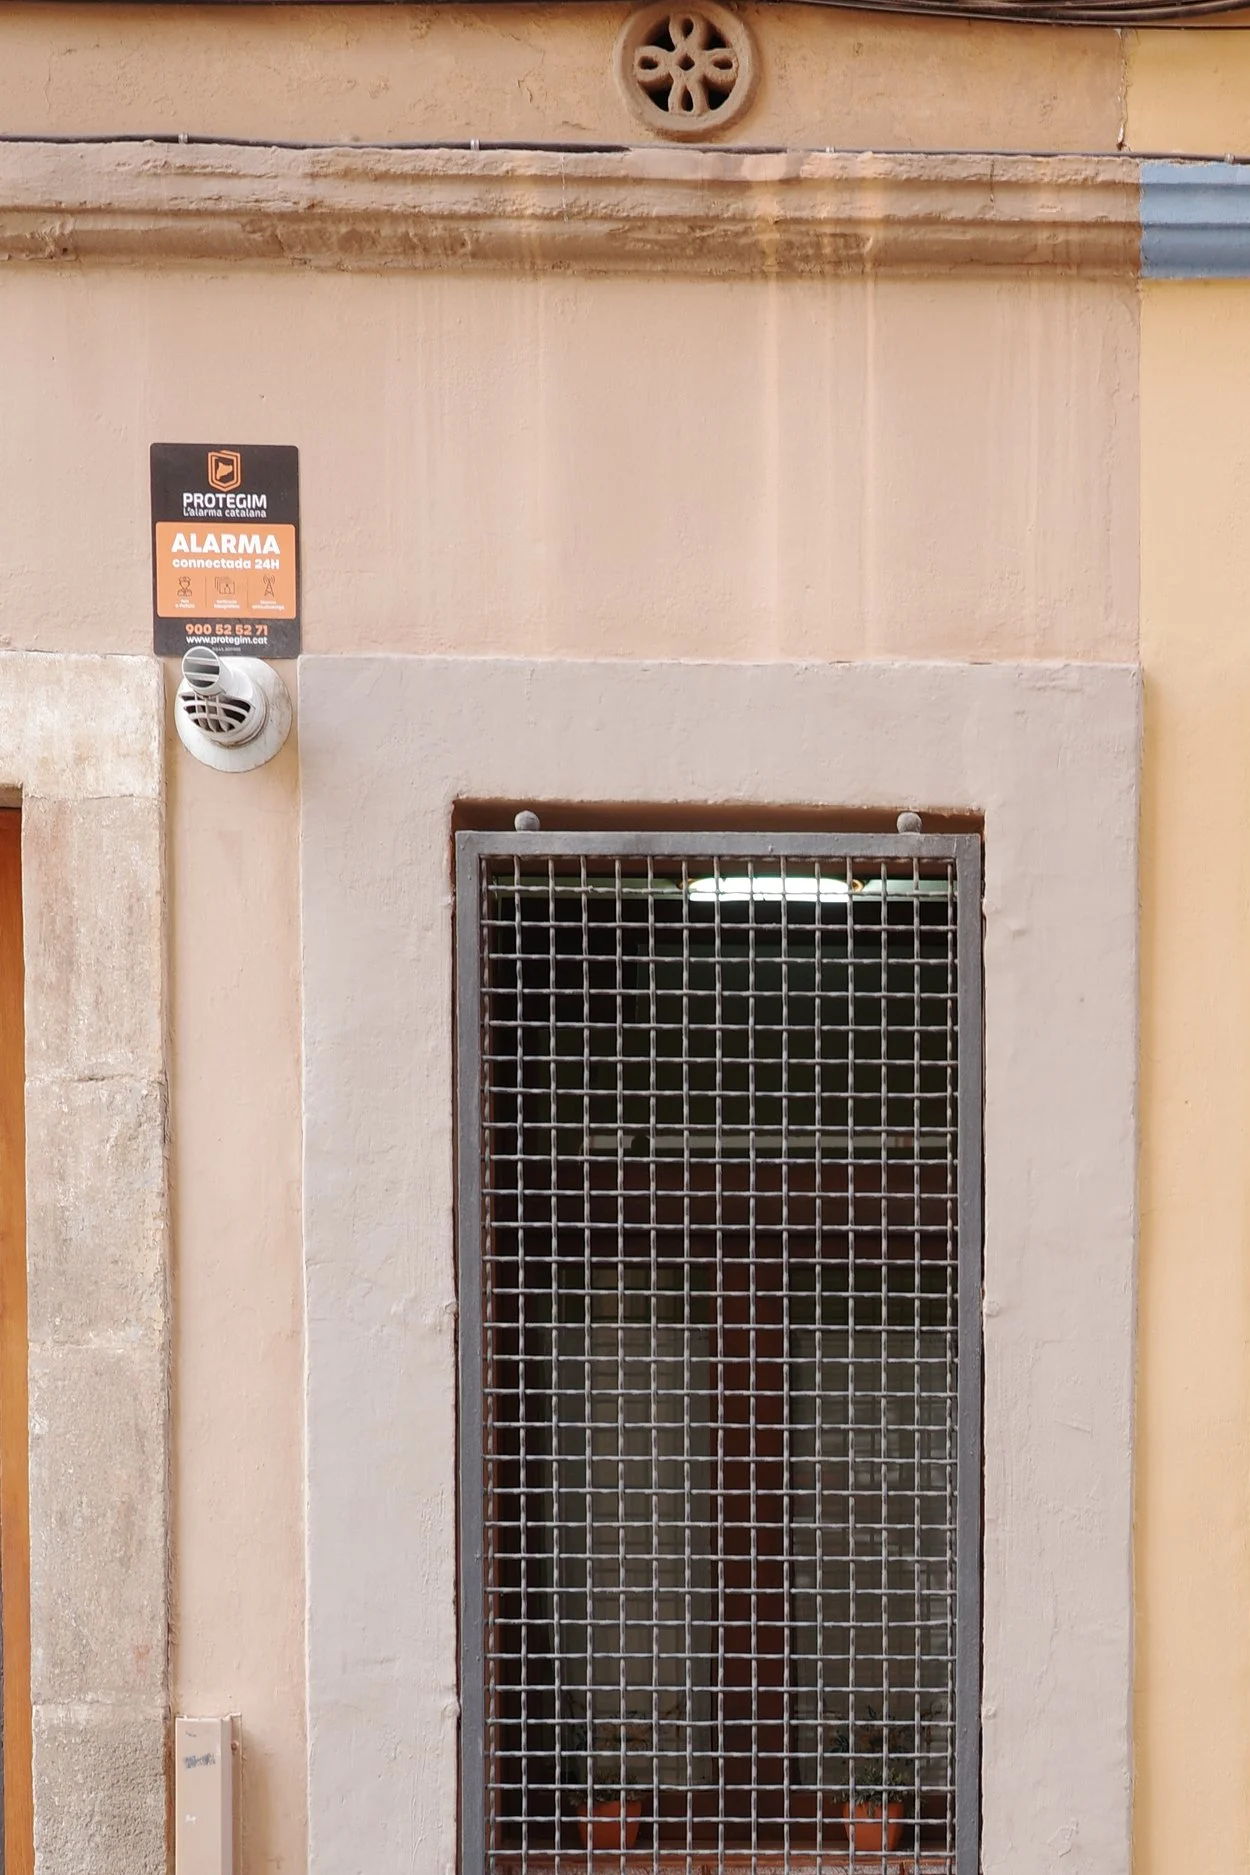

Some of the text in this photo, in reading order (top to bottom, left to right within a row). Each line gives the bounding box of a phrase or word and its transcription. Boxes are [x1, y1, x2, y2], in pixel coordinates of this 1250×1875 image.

[183, 493, 267, 509] PROTEGIM
[225, 508, 267, 518] catalana
[171, 532, 280, 554] ALARMA
[172, 558, 280, 570] connectada 24H
[186, 624, 268, 635] 900 52 52 71
[186, 635, 268, 645] www.protegim.cat
